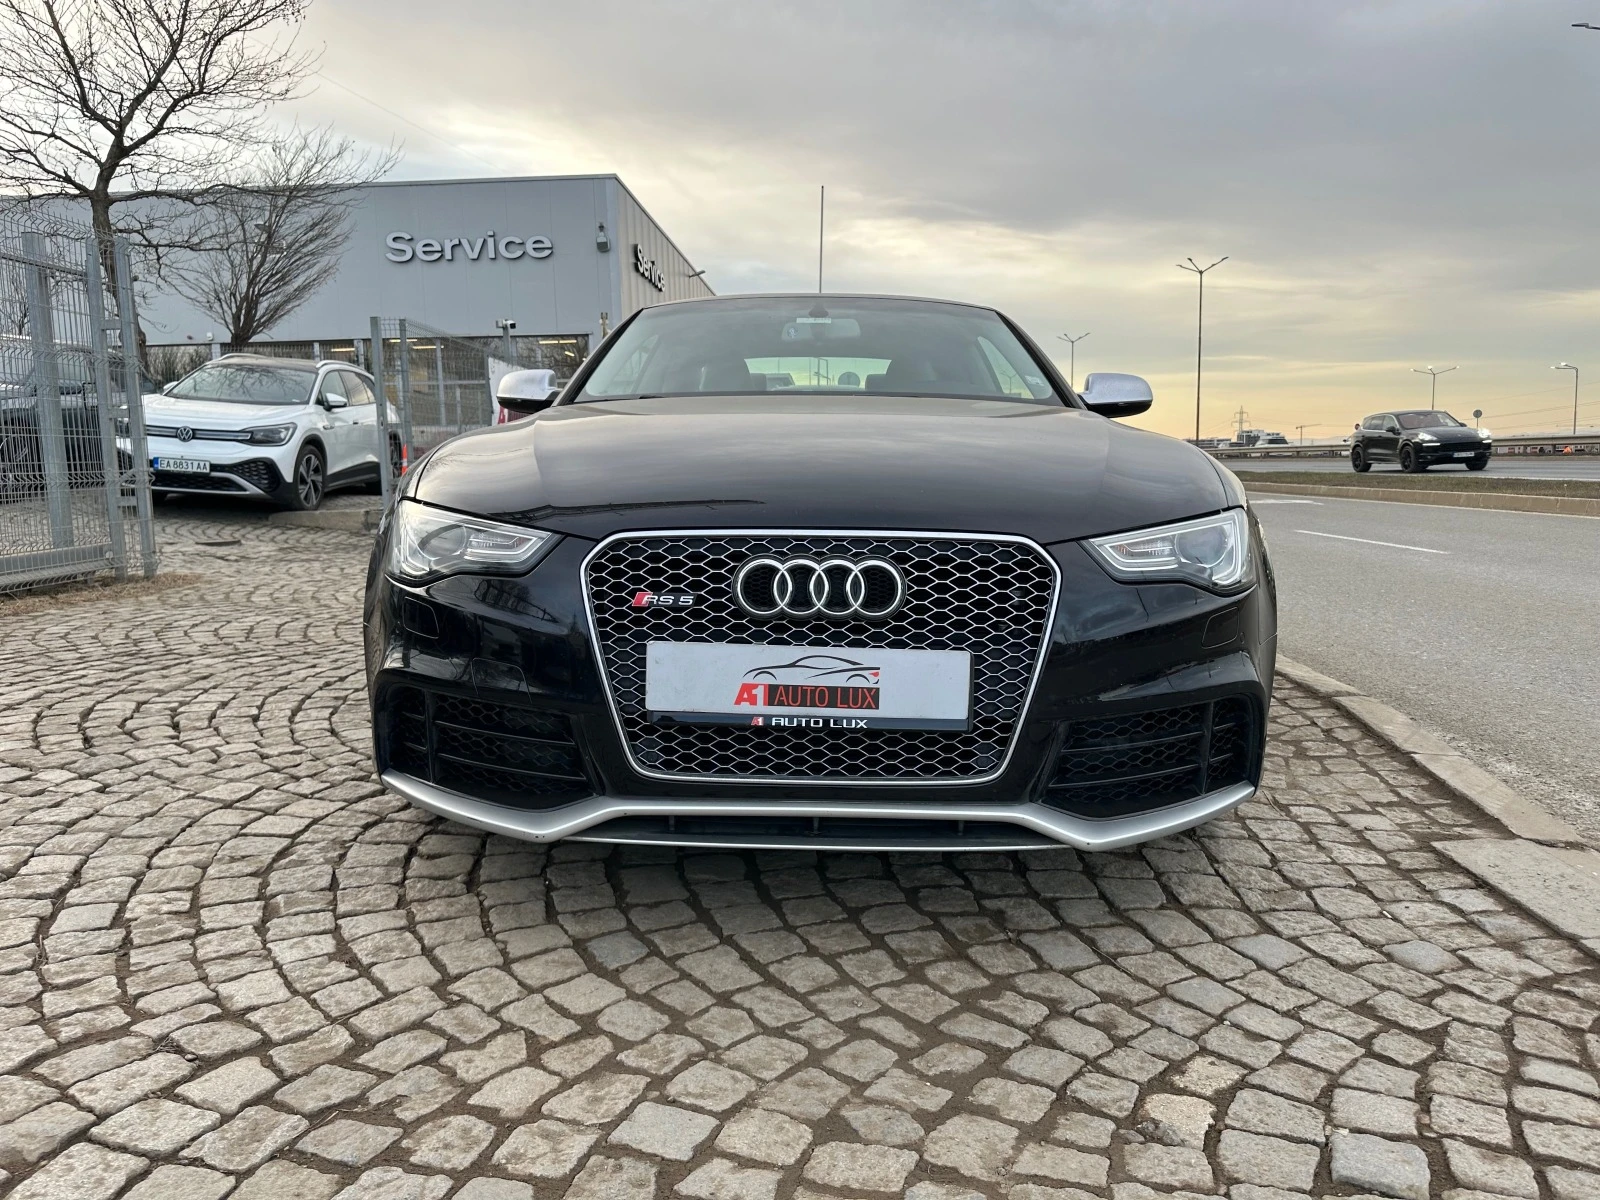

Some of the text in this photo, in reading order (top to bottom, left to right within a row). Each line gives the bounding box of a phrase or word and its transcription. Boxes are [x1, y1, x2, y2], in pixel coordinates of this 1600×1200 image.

[385, 230, 554, 263] Service
[634, 243, 666, 293] Service
[159, 460, 208, 471] EA 8831 AA
[641, 595, 694, 606] RS 5
[733, 683, 877, 709] A1 AUTO LUX
[751, 716, 868, 729] A1 AUTO LUX
